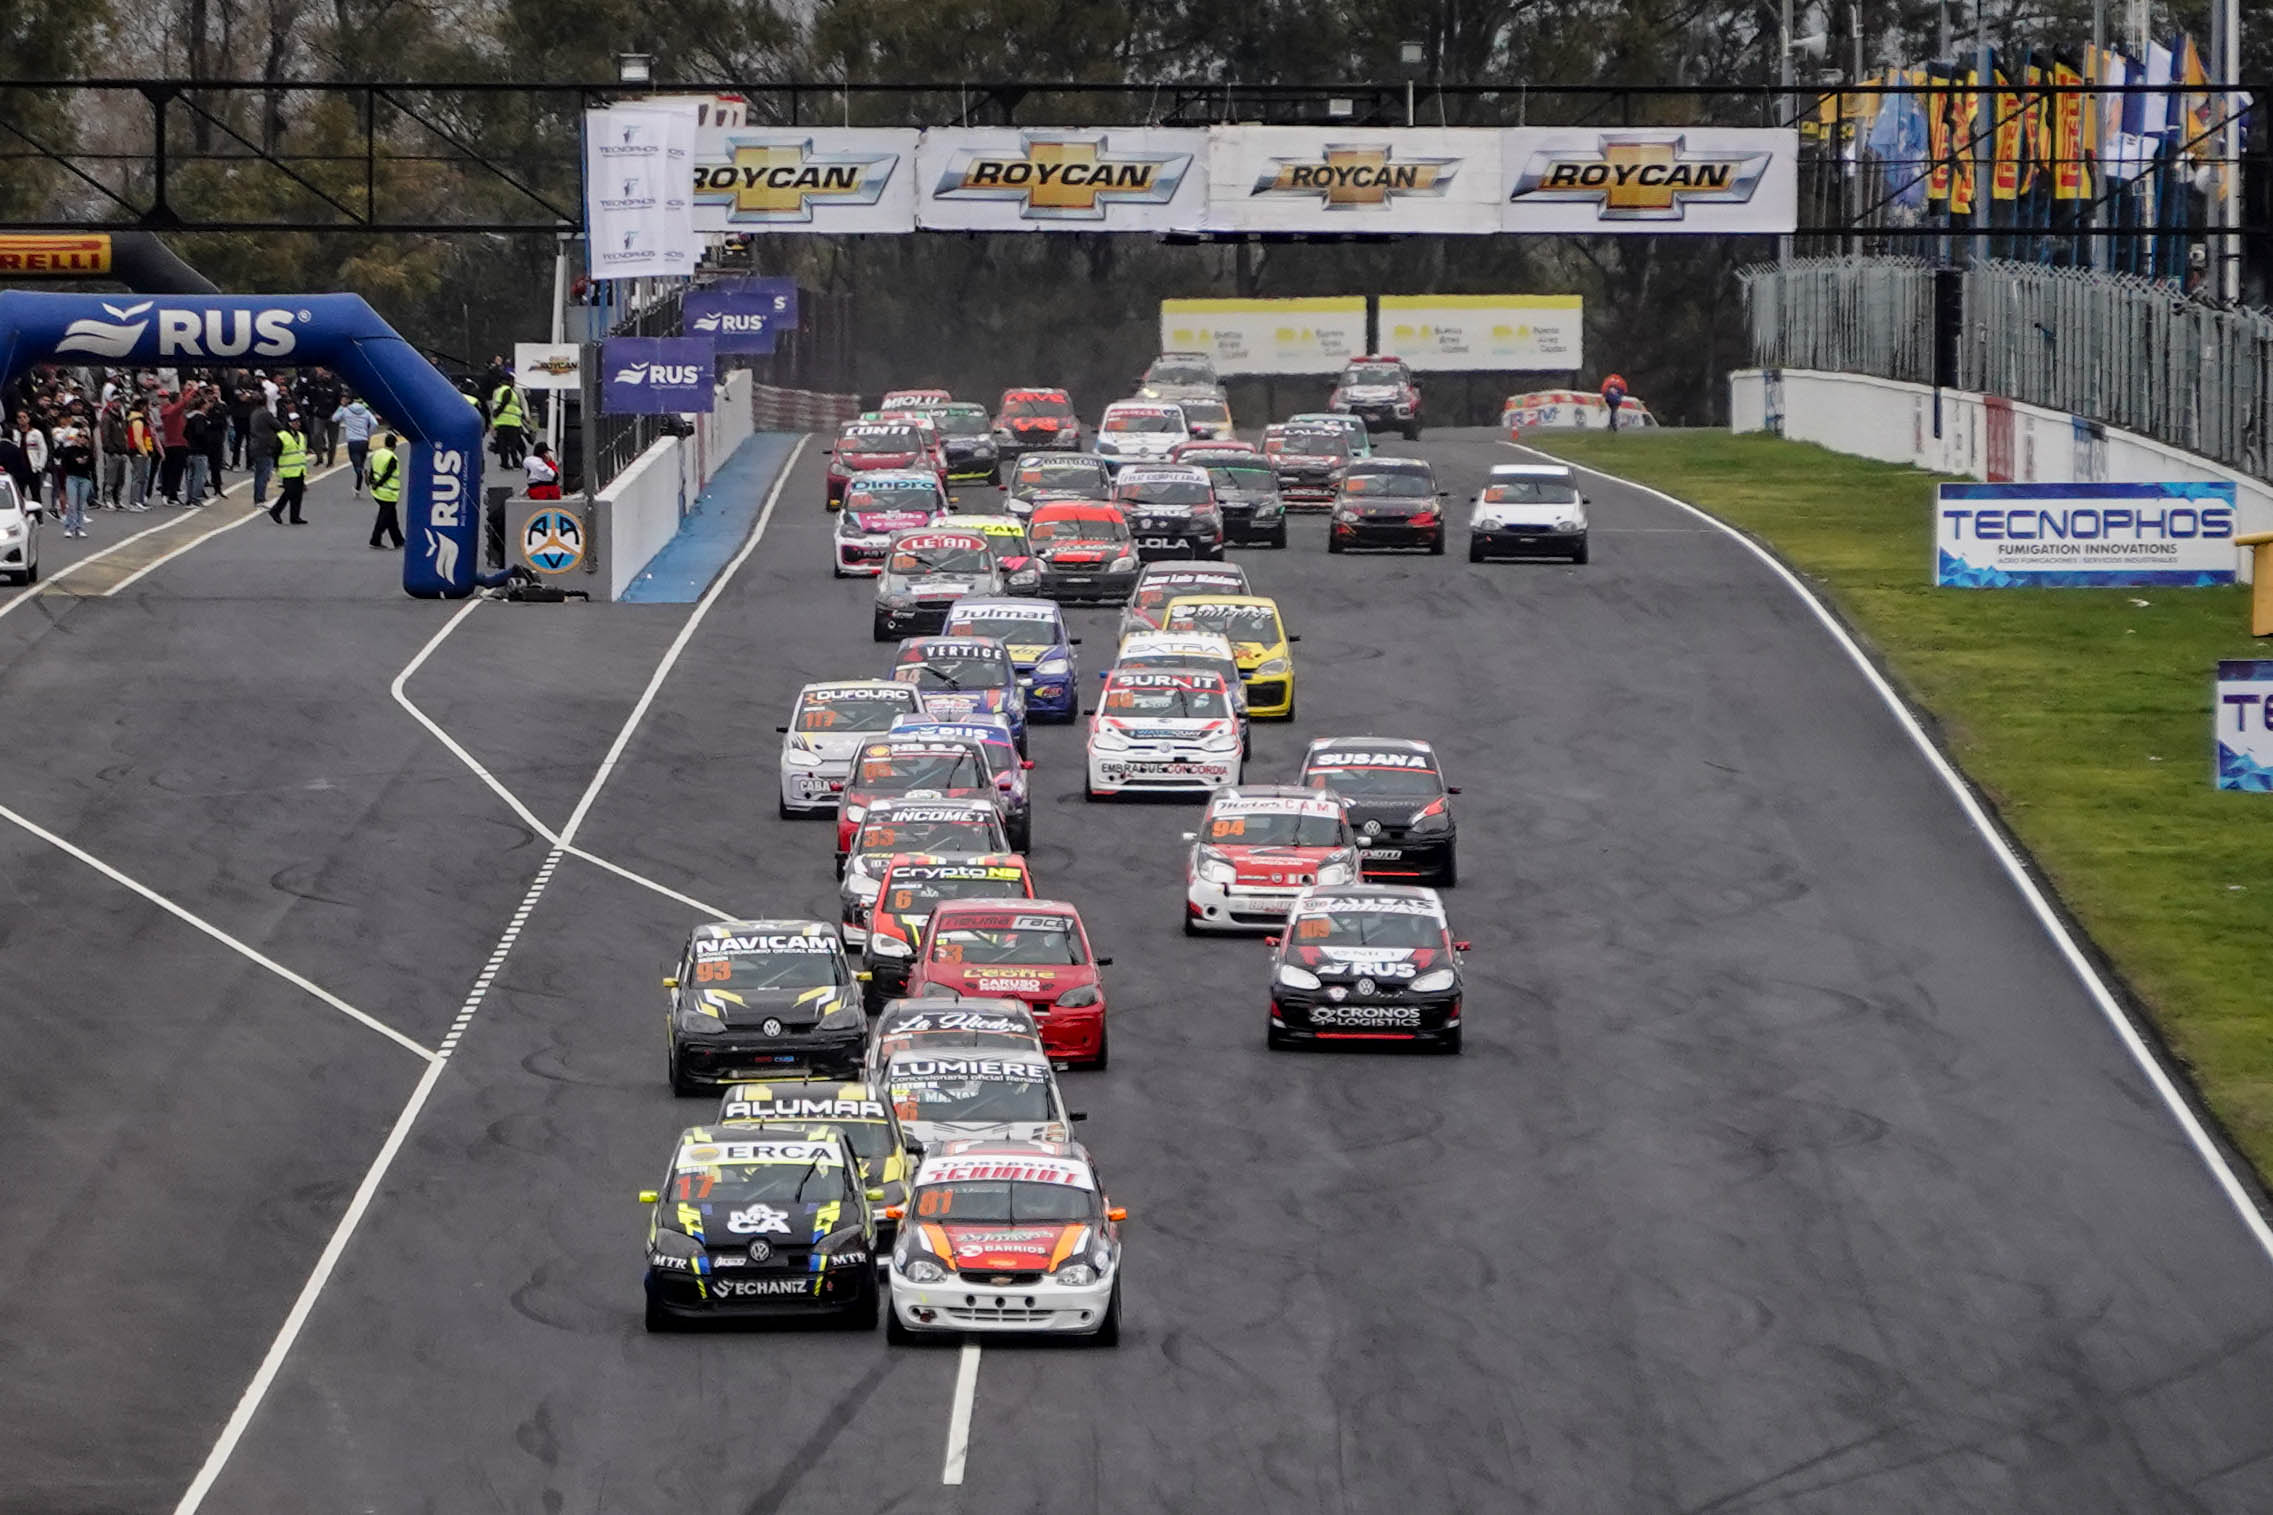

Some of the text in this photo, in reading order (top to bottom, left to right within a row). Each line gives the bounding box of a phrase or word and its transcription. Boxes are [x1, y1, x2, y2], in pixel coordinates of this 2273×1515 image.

[973, 163, 1152, 187] ROYCAN
[1292, 166, 1417, 189] ROYCAN
[1550, 164, 1729, 187] ROYCAN
[722, 315, 763, 330] RUS
[159, 310, 296, 357] RUS
[650, 365, 698, 384] RUS
[431, 450, 462, 526] RUS
[1943, 509, 2233, 539] TECNOPHOS
[1998, 543, 2177, 554] FUMIGATION INNOVATIONS
[816, 689, 909, 700] DUFOURC
[804, 711, 836, 728] 117
[1316, 753, 1427, 768] SUSANA
[1164, 763, 1228, 775] CONCORDIA
[1212, 820, 1245, 837] 94
[863, 829, 895, 847] 33
[892, 867, 987, 880] Crypto
[895, 890, 912, 909] 6
[696, 936, 836, 951] NAVICAM
[697, 962, 732, 982] 93
[1353, 962, 1416, 977] RUS
[1337, 1008, 1420, 1018] CRONOS
[1337, 1018, 1421, 1026] LOGISTICS
[891, 1062, 1047, 1076] LUMIERE
[726, 1100, 885, 1117] ALUMAR
[727, 1146, 832, 1160] ERCA
[676, 1176, 714, 1199] 17
[985, 1246, 1045, 1254] BARRIOS
[653, 1255, 687, 1270] MTR
[830, 1253, 867, 1266] MTR
